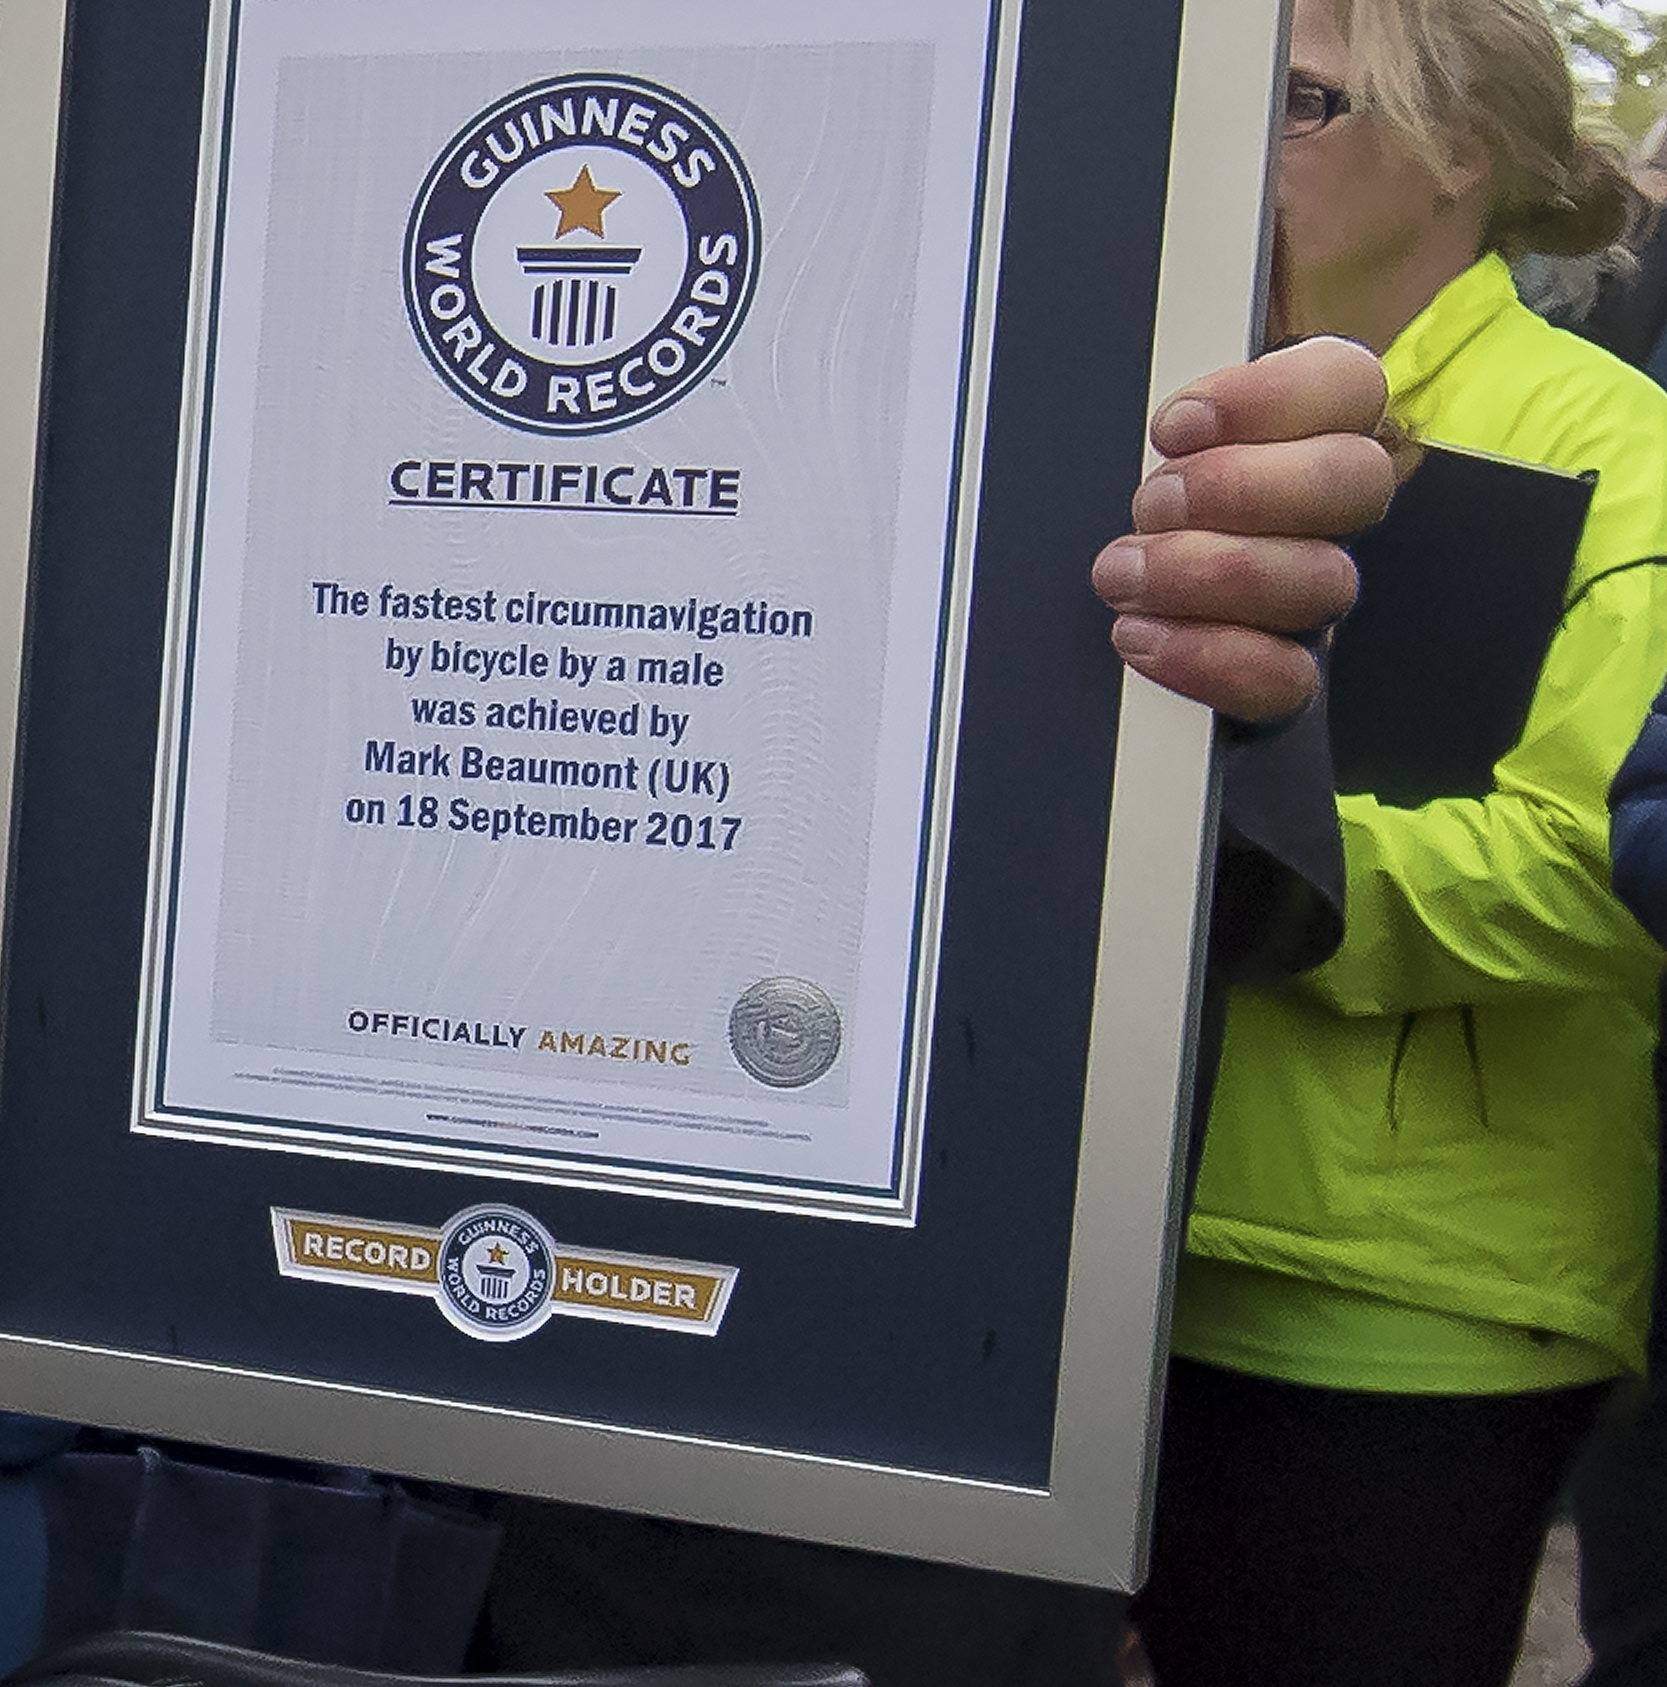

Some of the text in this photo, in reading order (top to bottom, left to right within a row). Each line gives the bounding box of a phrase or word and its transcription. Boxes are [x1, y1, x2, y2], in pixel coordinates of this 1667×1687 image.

[460, 97, 716, 189] GUINNESS
[425, 233, 738, 414] WORLD RECORDS
[390, 460, 741, 508] CERTIFICATE
[312, 581, 813, 639] The fastest circumnavigation
[385, 638, 725, 687] by bicycle by a male
[411, 695, 689, 746] was achieved by
[365, 740, 731, 803] Mark Beaumont (UK)
[345, 794, 743, 851] on 18 September 2017
[347, 1010, 692, 1066] OFFICIALLY AMAZING
[457, 1219, 539, 1254] GUINNESS
[302, 1231, 698, 1310] RECORD HOLDER
[447, 1257, 546, 1321] WORLD RECORDS
